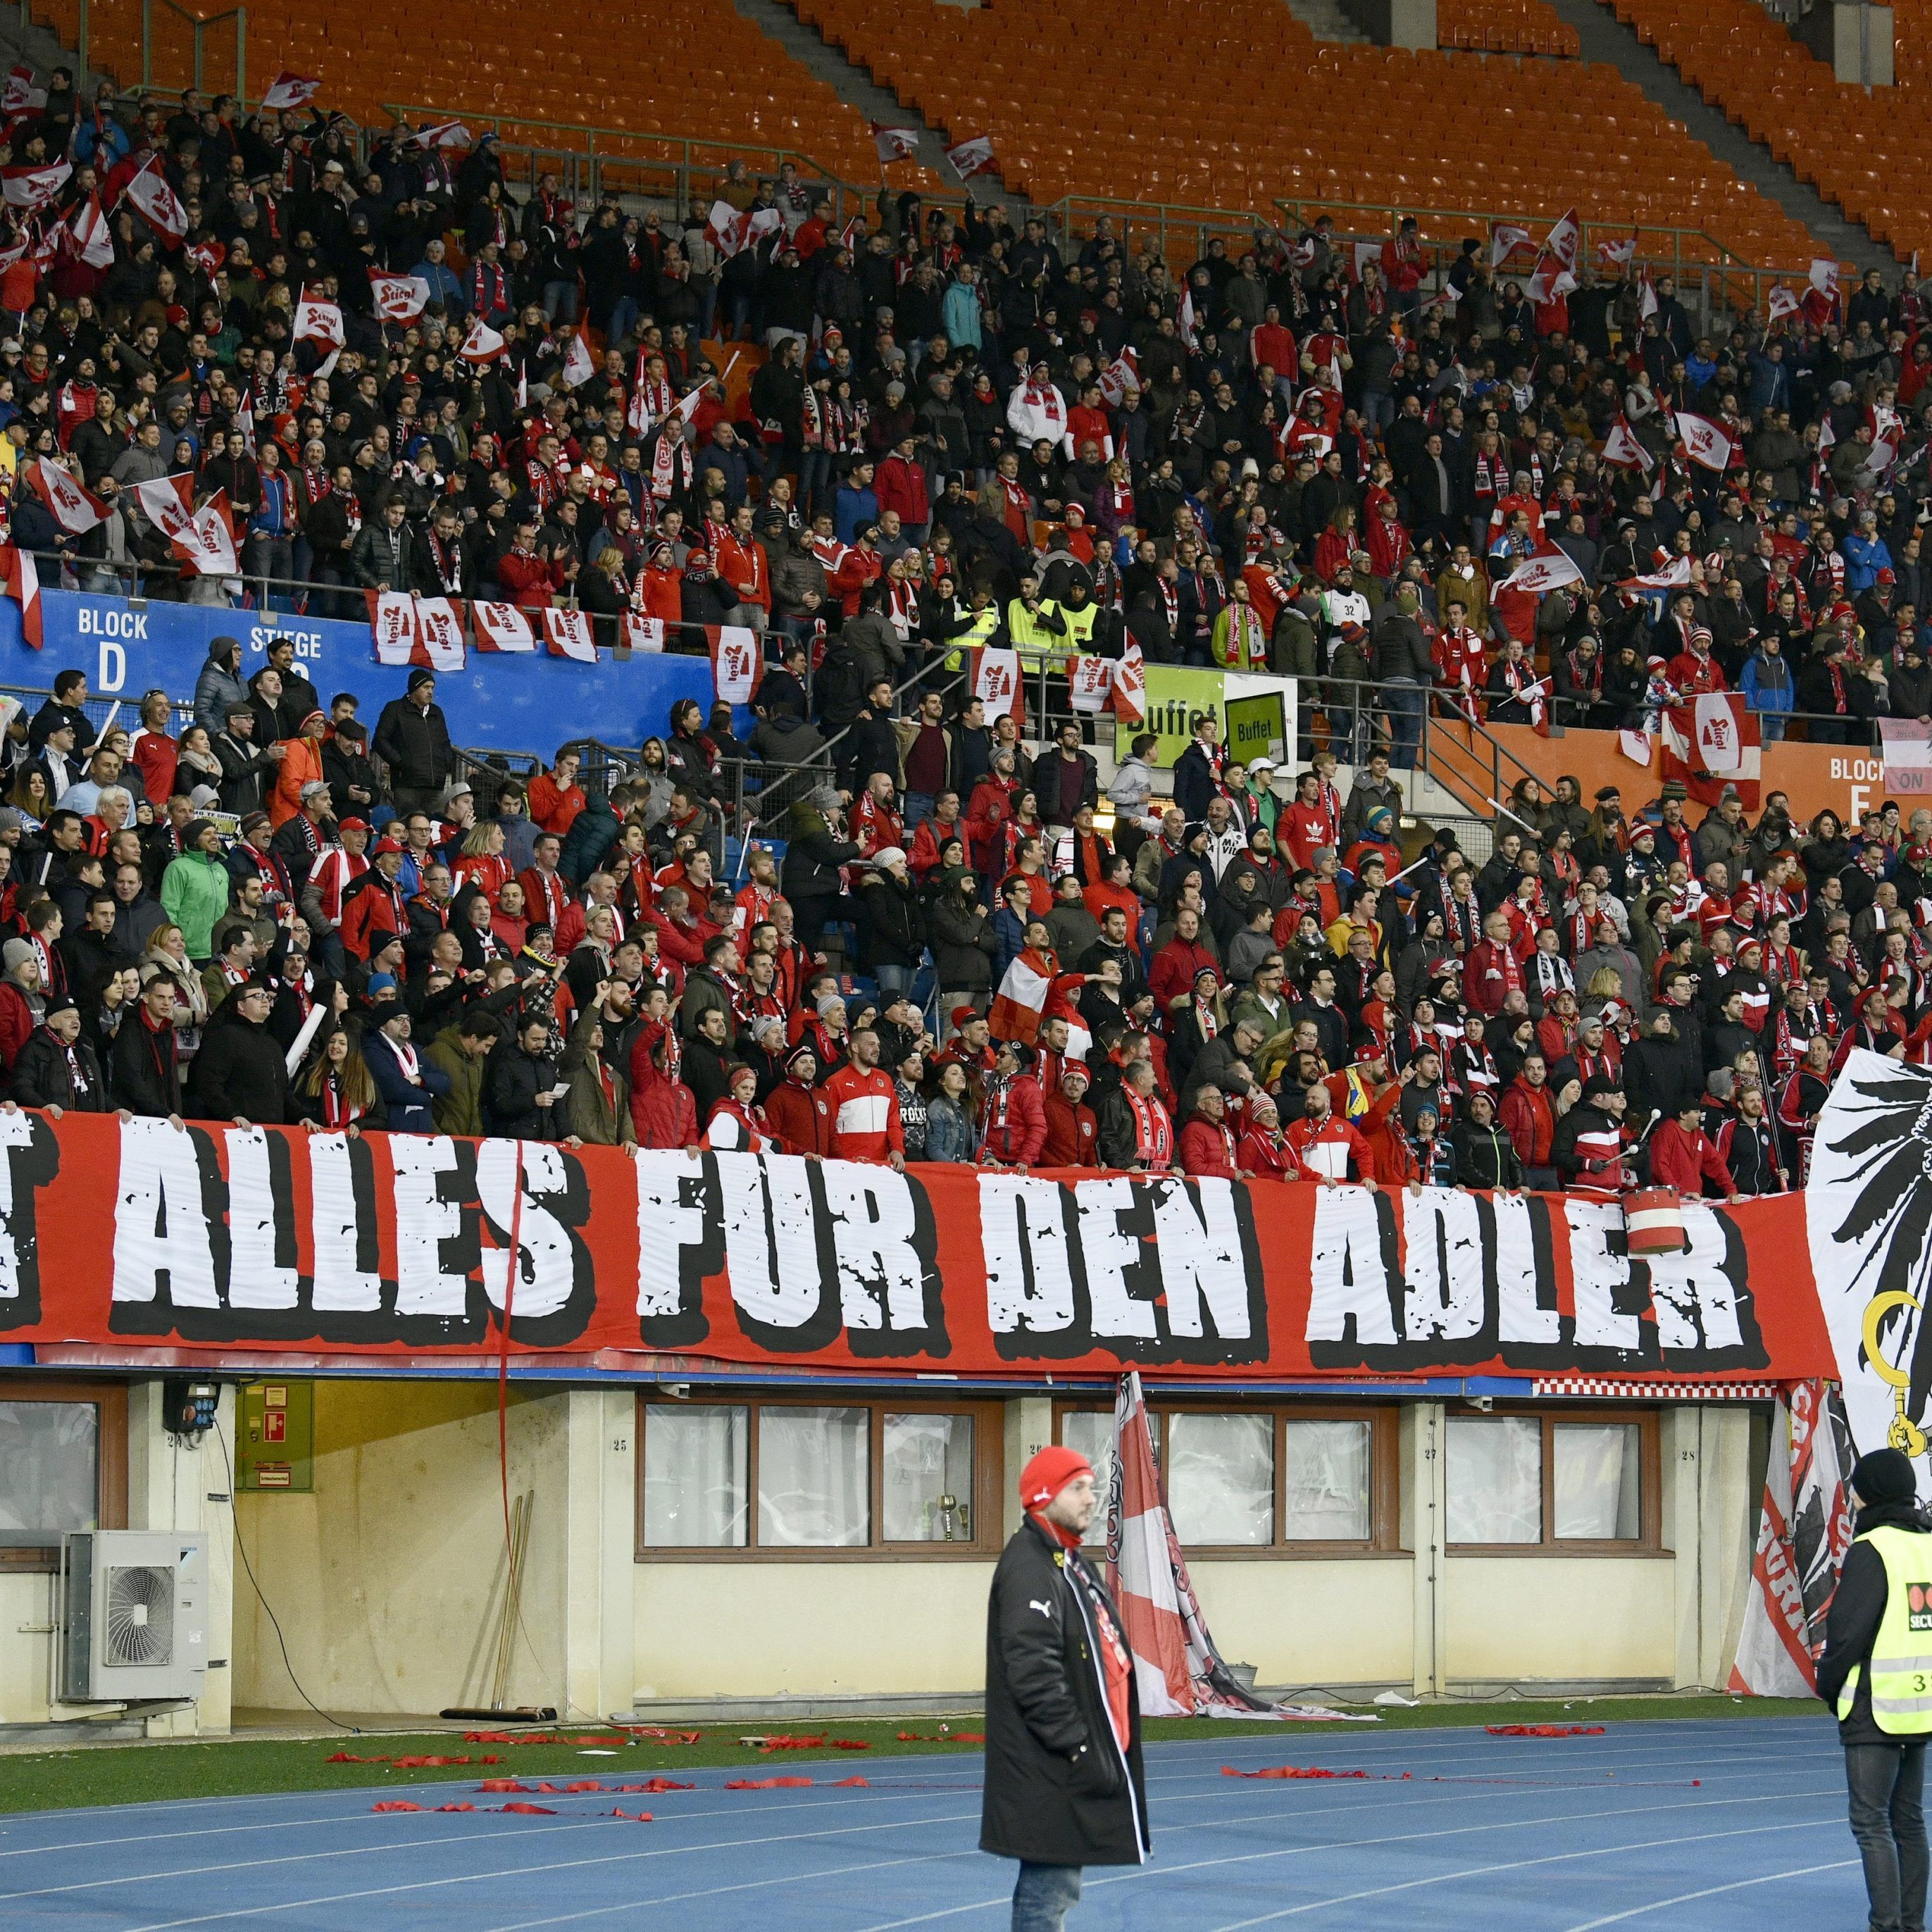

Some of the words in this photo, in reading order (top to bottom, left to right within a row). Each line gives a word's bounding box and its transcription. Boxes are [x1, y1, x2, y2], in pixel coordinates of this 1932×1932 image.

[380, 285, 416, 305] Stiegl
[308, 307, 337, 328] Stiegl
[1104, 364, 1126, 392] Stieg
[78, 609, 148, 639] BLOCK
[490, 602, 518, 632] Stiegl
[1345, 606, 1354, 616] 32
[430, 612, 451, 651] Stiegl
[562, 610, 581, 644] Stiegl
[99, 641, 126, 692] D
[1238, 719, 1272, 742] Buffet
[1709, 718, 1728, 750] Stiegl
[1899, 773, 1923, 789] ON
[112, 1115, 575, 1319] ALLES
[978, 1173, 1251, 1339] DEN
[1304, 1185, 1743, 1350] ADLER
[613, 1439, 628, 1452] 25
[1682, 1451, 1695, 1461] 28
